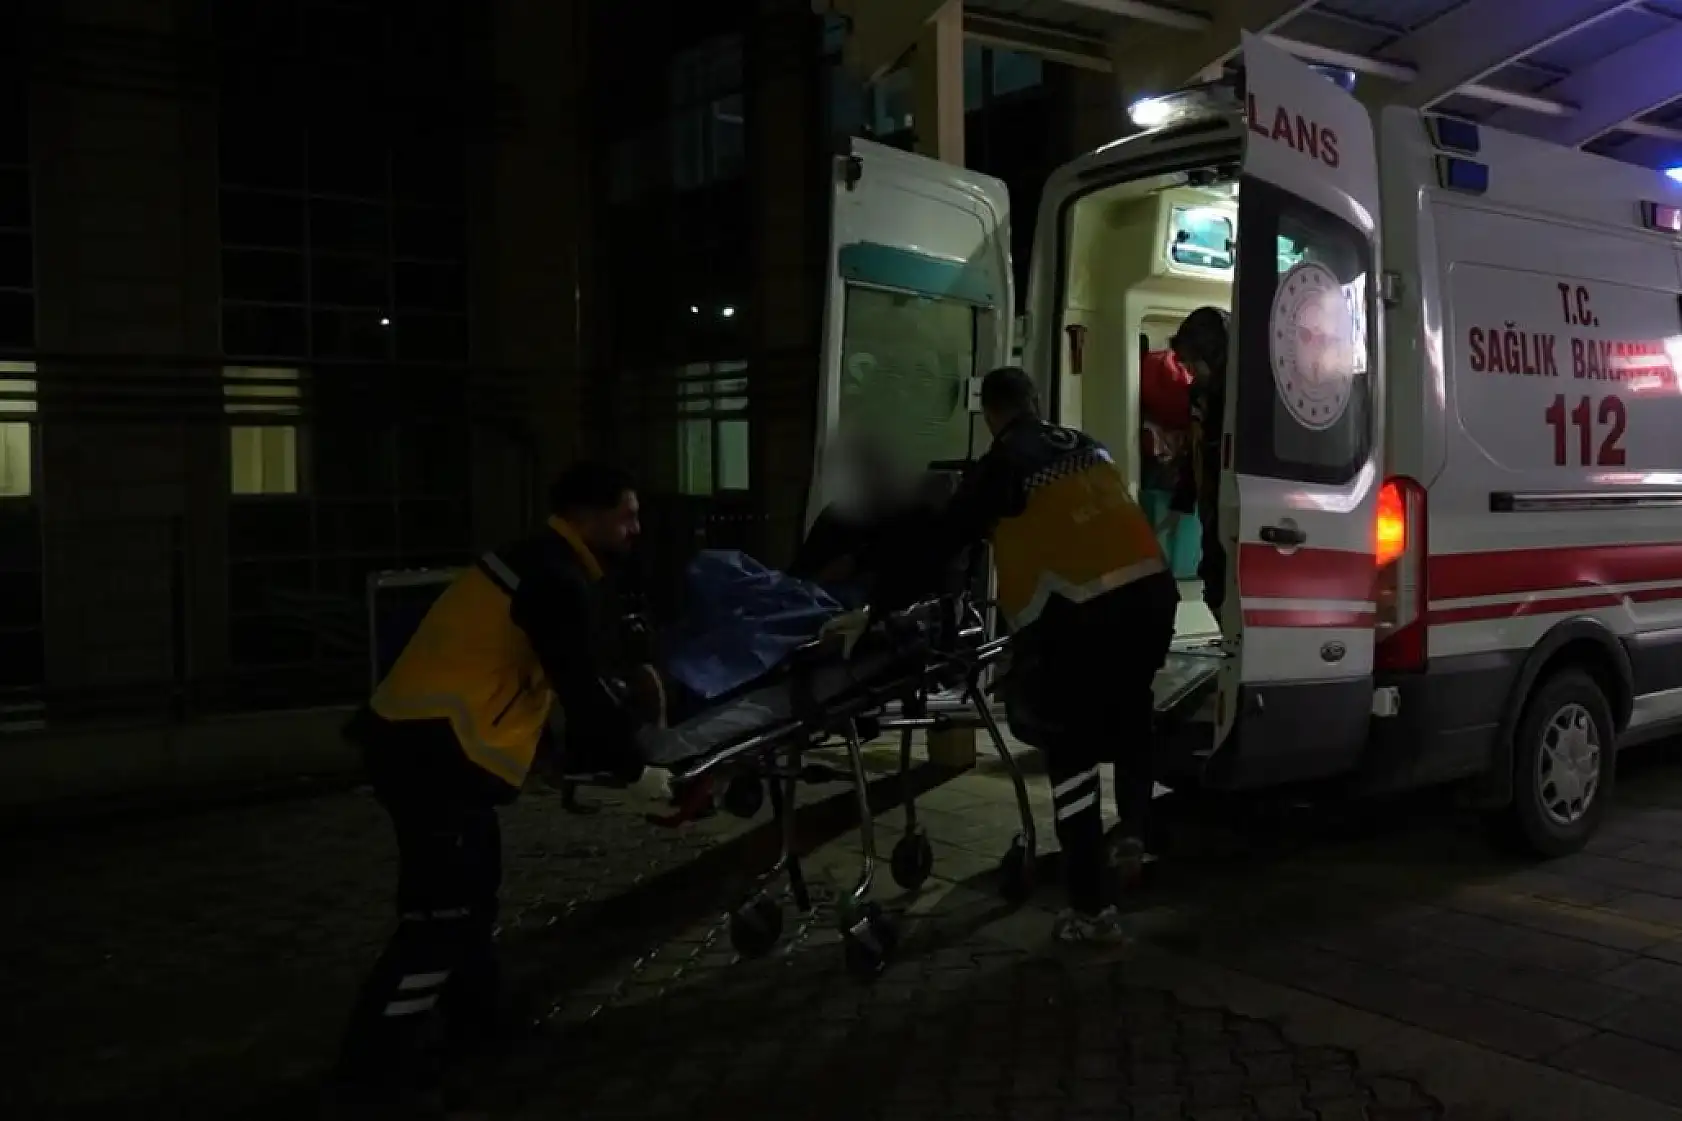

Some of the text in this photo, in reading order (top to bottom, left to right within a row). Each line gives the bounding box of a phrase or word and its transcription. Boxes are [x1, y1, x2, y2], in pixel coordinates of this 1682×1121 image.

[1558, 282, 1599, 327] T.C.
[1469, 320, 1558, 377] SAĞLIK
[1545, 393, 1626, 467] 112
